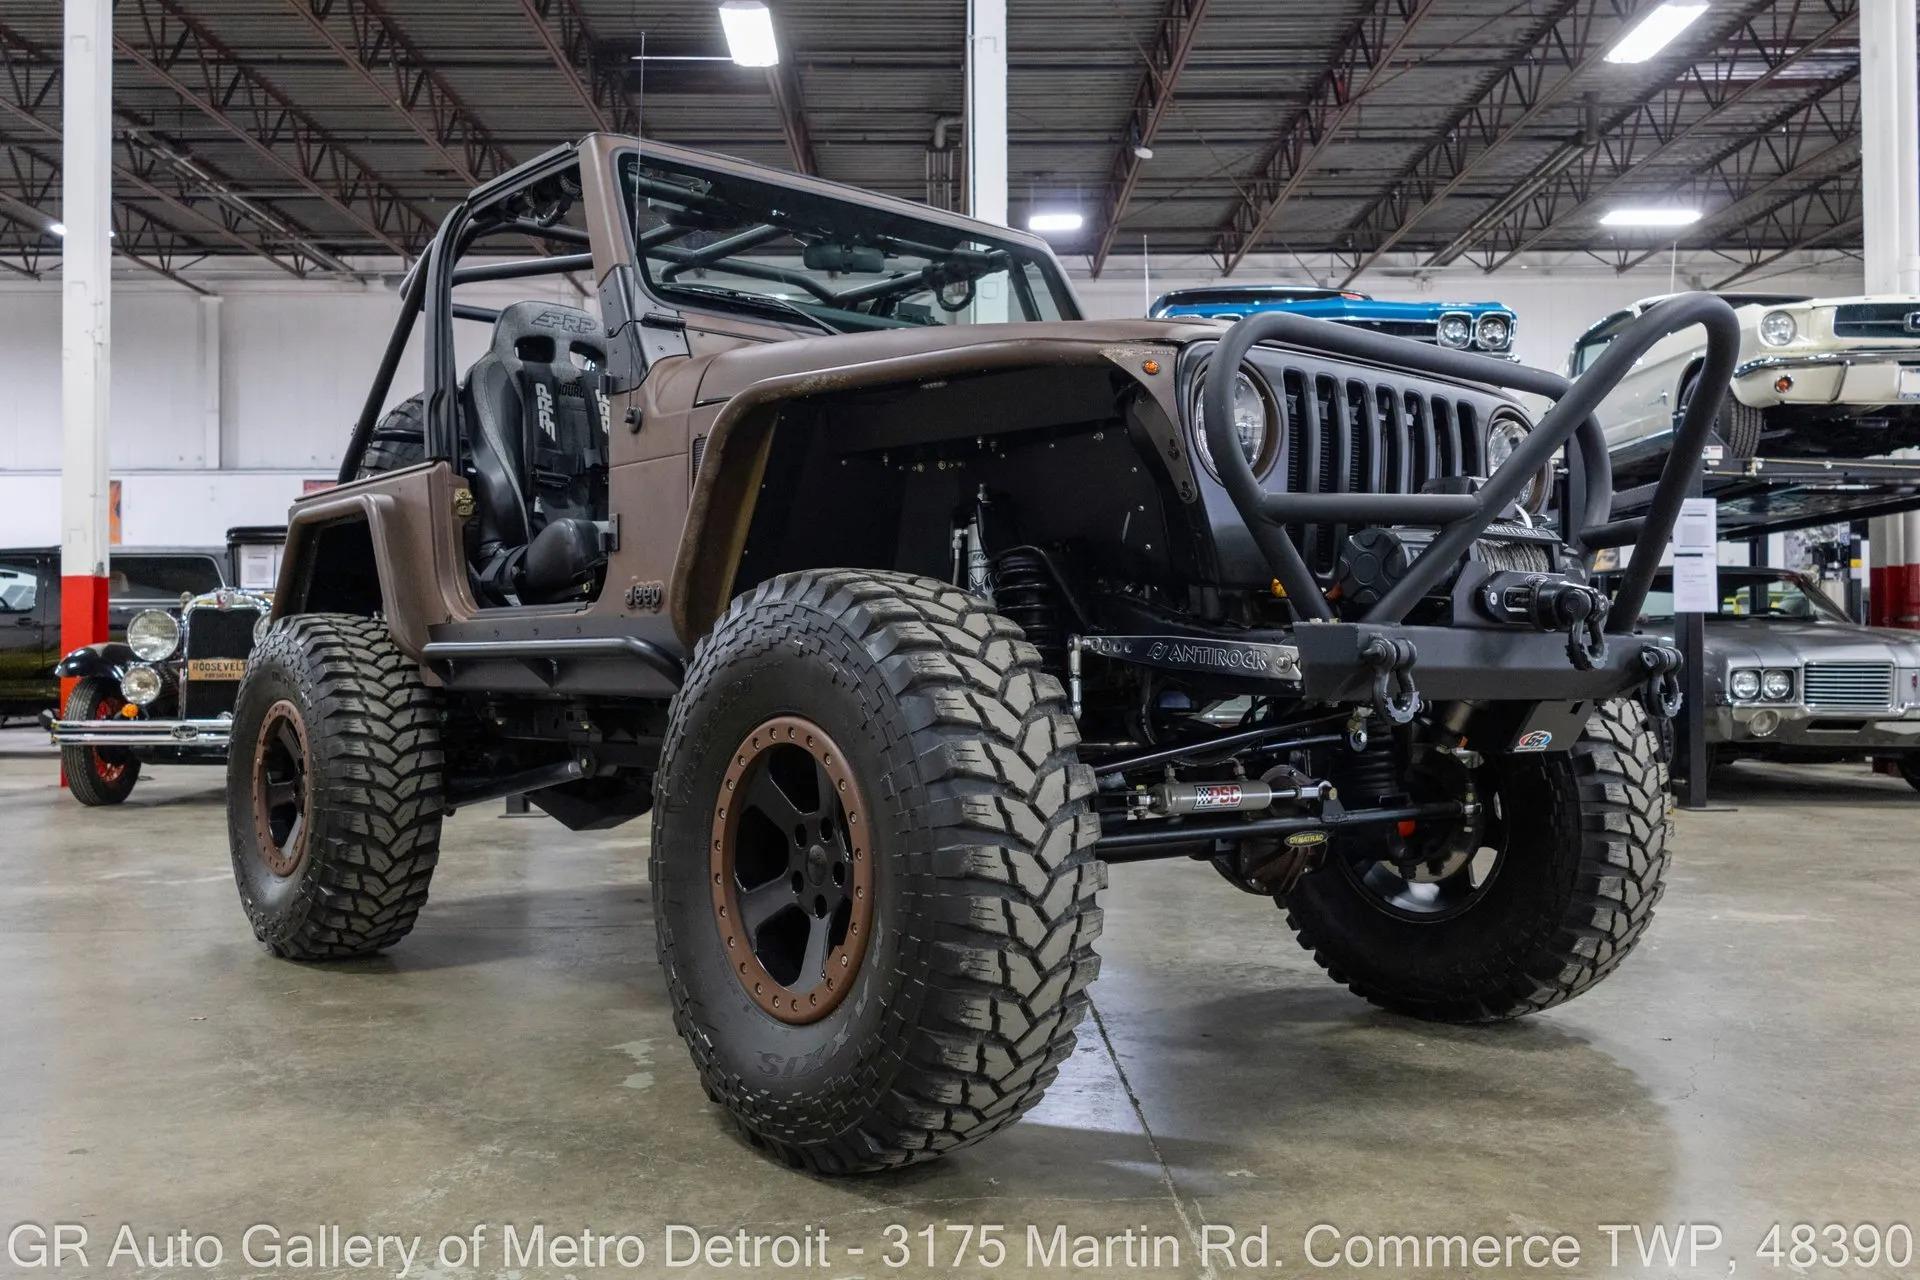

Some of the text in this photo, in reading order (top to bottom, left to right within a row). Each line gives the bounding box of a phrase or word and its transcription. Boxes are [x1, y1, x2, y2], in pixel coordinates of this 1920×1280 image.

[535, 383, 556, 442] PRP
[625, 582, 662, 613] Jeep
[192, 662, 247, 671] ROOSEVELT
[1168, 643, 1268, 671] ANTIROCK
[1208, 786, 1240, 804] PSC
